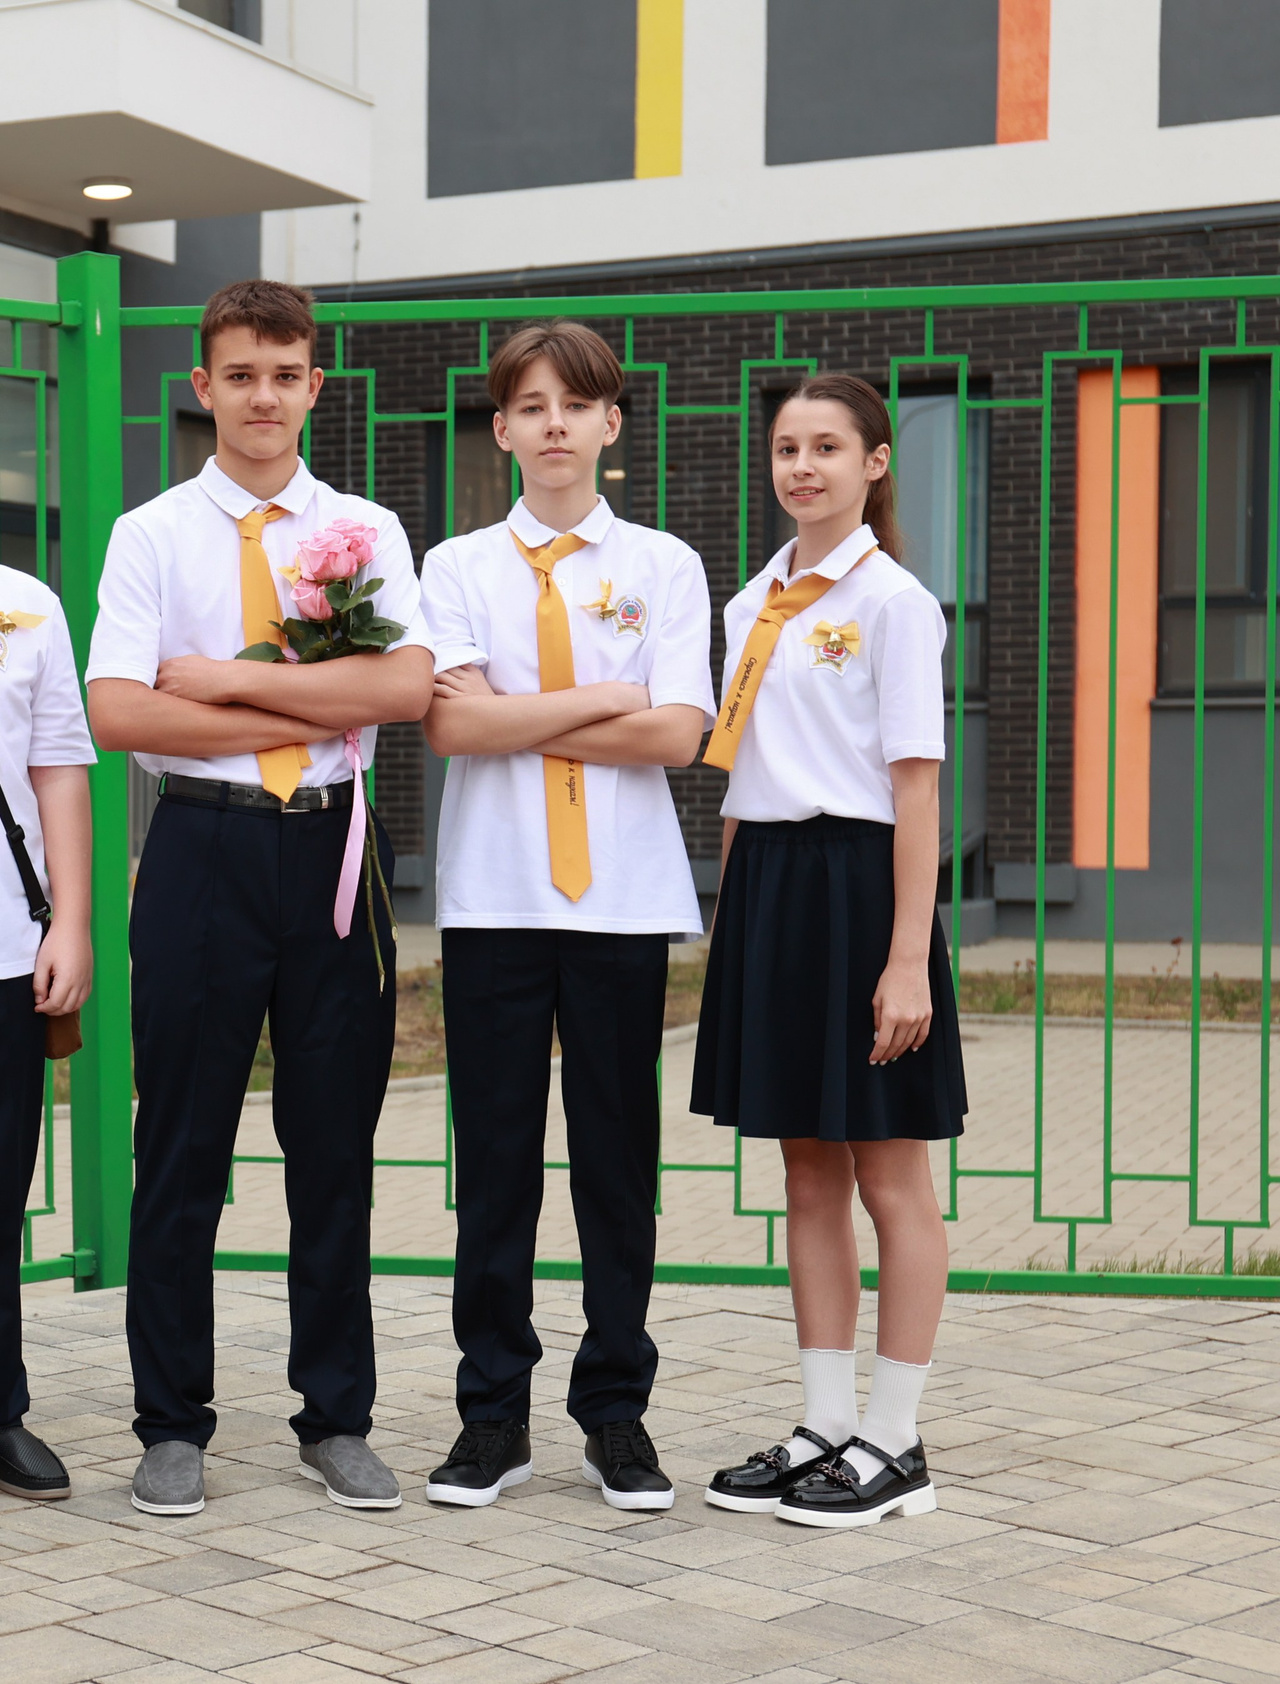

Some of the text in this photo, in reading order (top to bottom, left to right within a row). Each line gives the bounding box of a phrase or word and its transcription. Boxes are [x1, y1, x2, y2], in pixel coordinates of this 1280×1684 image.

[738, 656, 758, 691] Стремись
[724, 700, 740, 733] наукам!
[565, 775, 579, 806] наукам!
